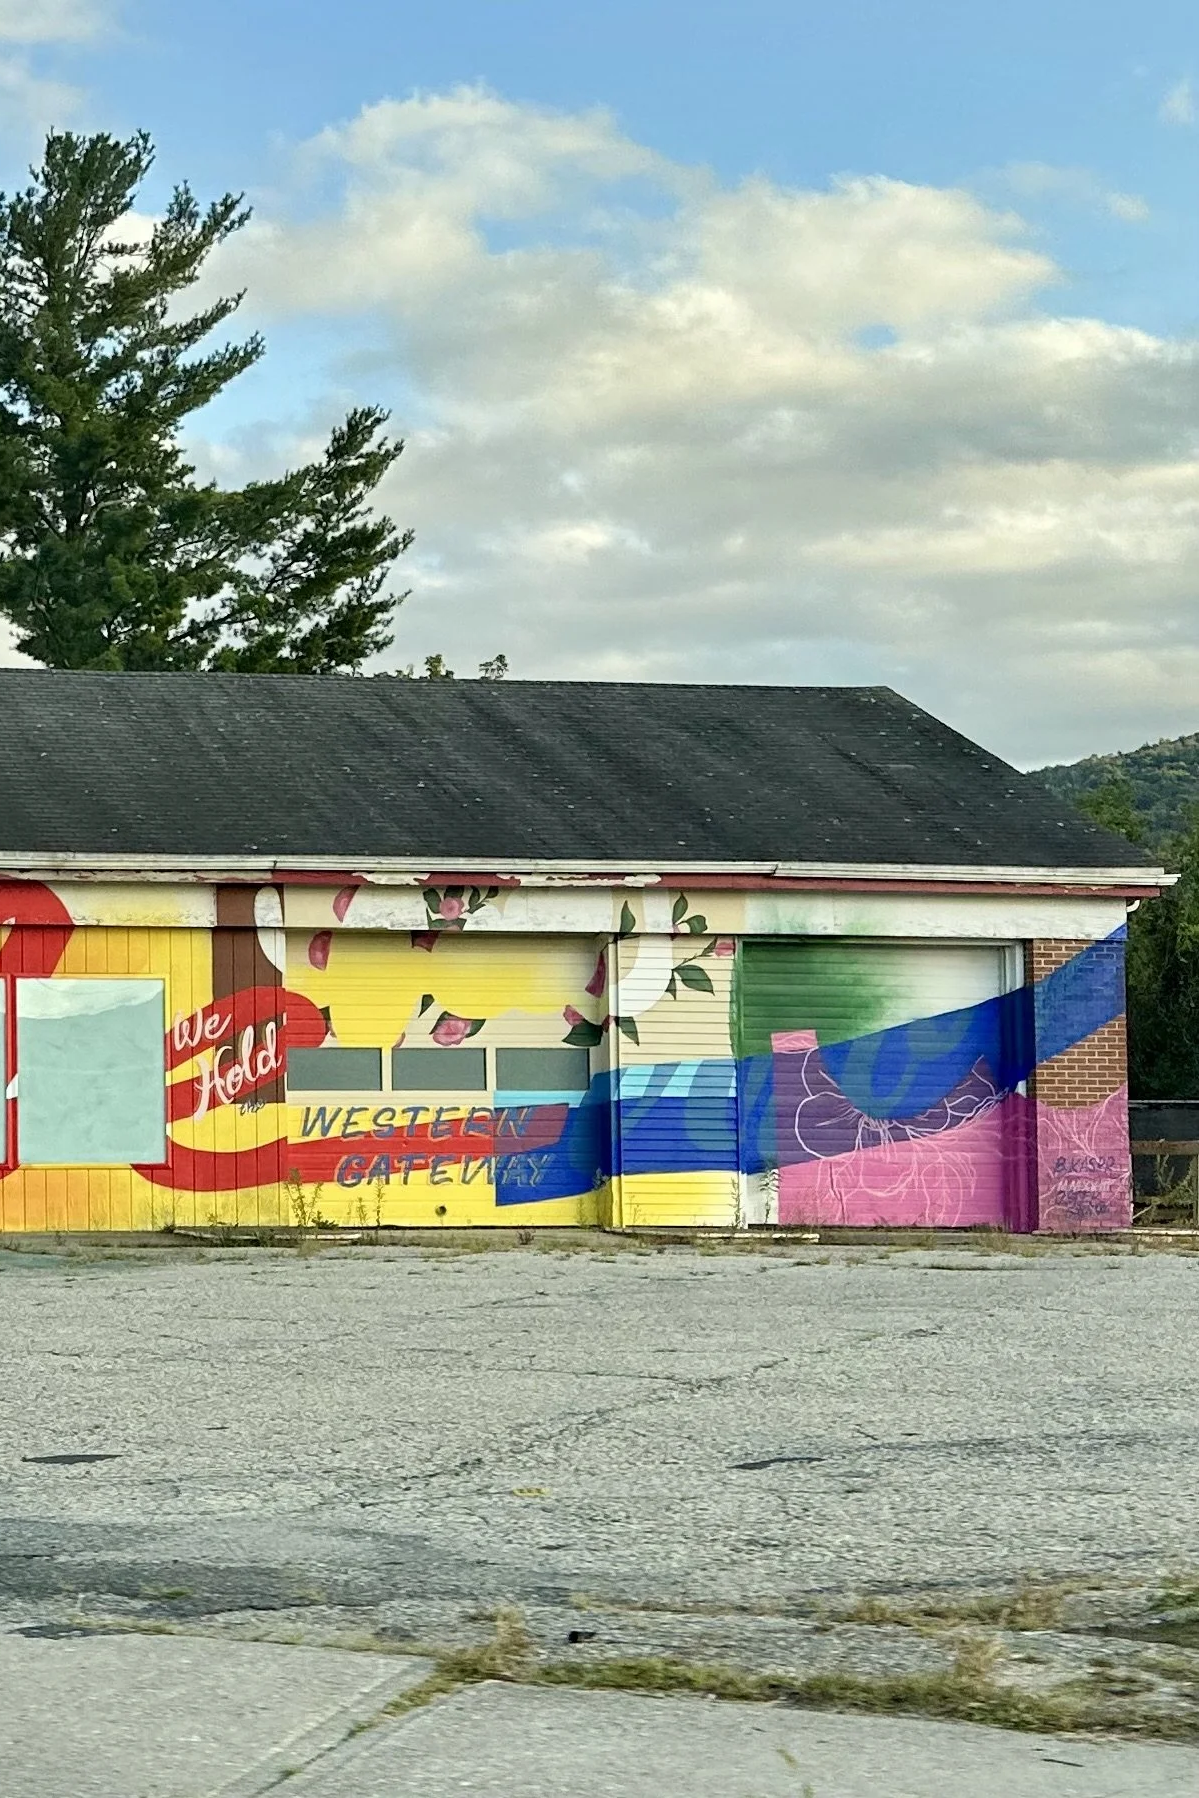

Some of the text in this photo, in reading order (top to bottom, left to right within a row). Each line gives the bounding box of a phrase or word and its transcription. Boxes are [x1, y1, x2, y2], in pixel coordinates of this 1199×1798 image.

[173, 1007, 233, 1051] We
[300, 1105, 536, 1141] WESTERN
[334, 1153, 558, 1188] GATEWAY
